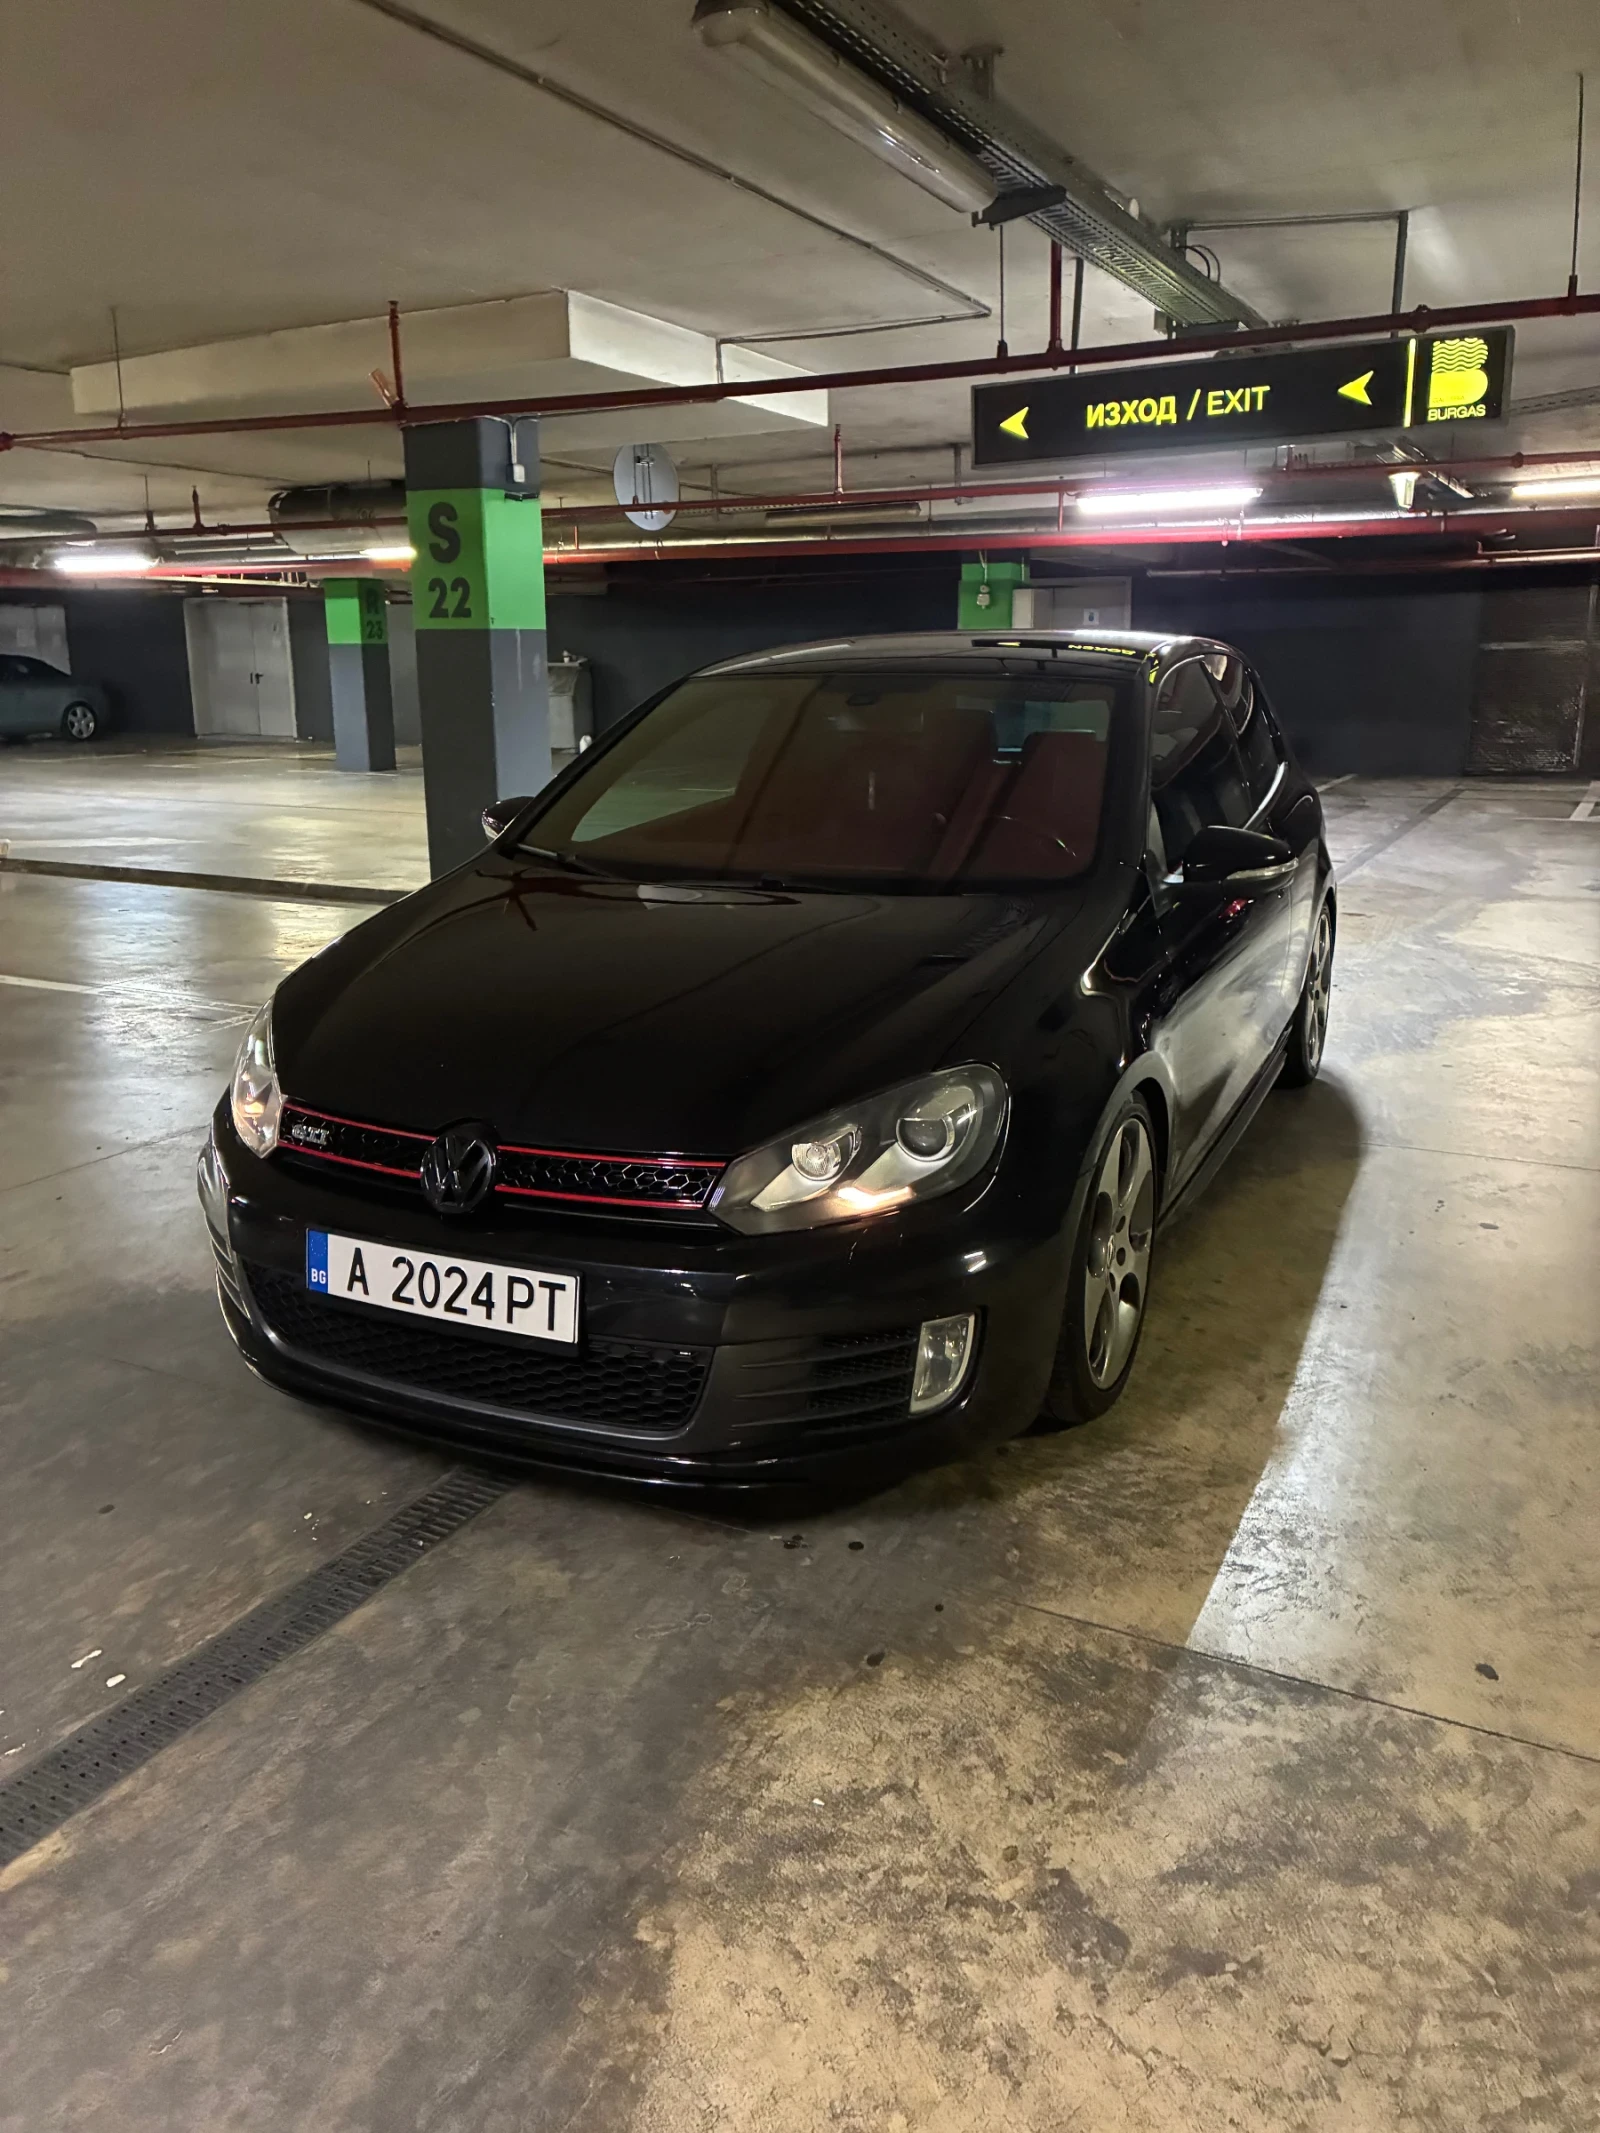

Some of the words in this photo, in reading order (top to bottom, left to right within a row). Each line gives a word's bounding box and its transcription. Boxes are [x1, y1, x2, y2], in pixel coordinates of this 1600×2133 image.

[1086, 395, 1177, 428] ИЗХОД
[1207, 385, 1271, 416] EXIT
[1427, 404, 1486, 422] BURGAS
[428, 502, 461, 564] S
[428, 577, 472, 618] 22
[366, 620, 383, 640] 23
[311, 1268, 327, 1284] BG
[346, 1247, 370, 1296] A
